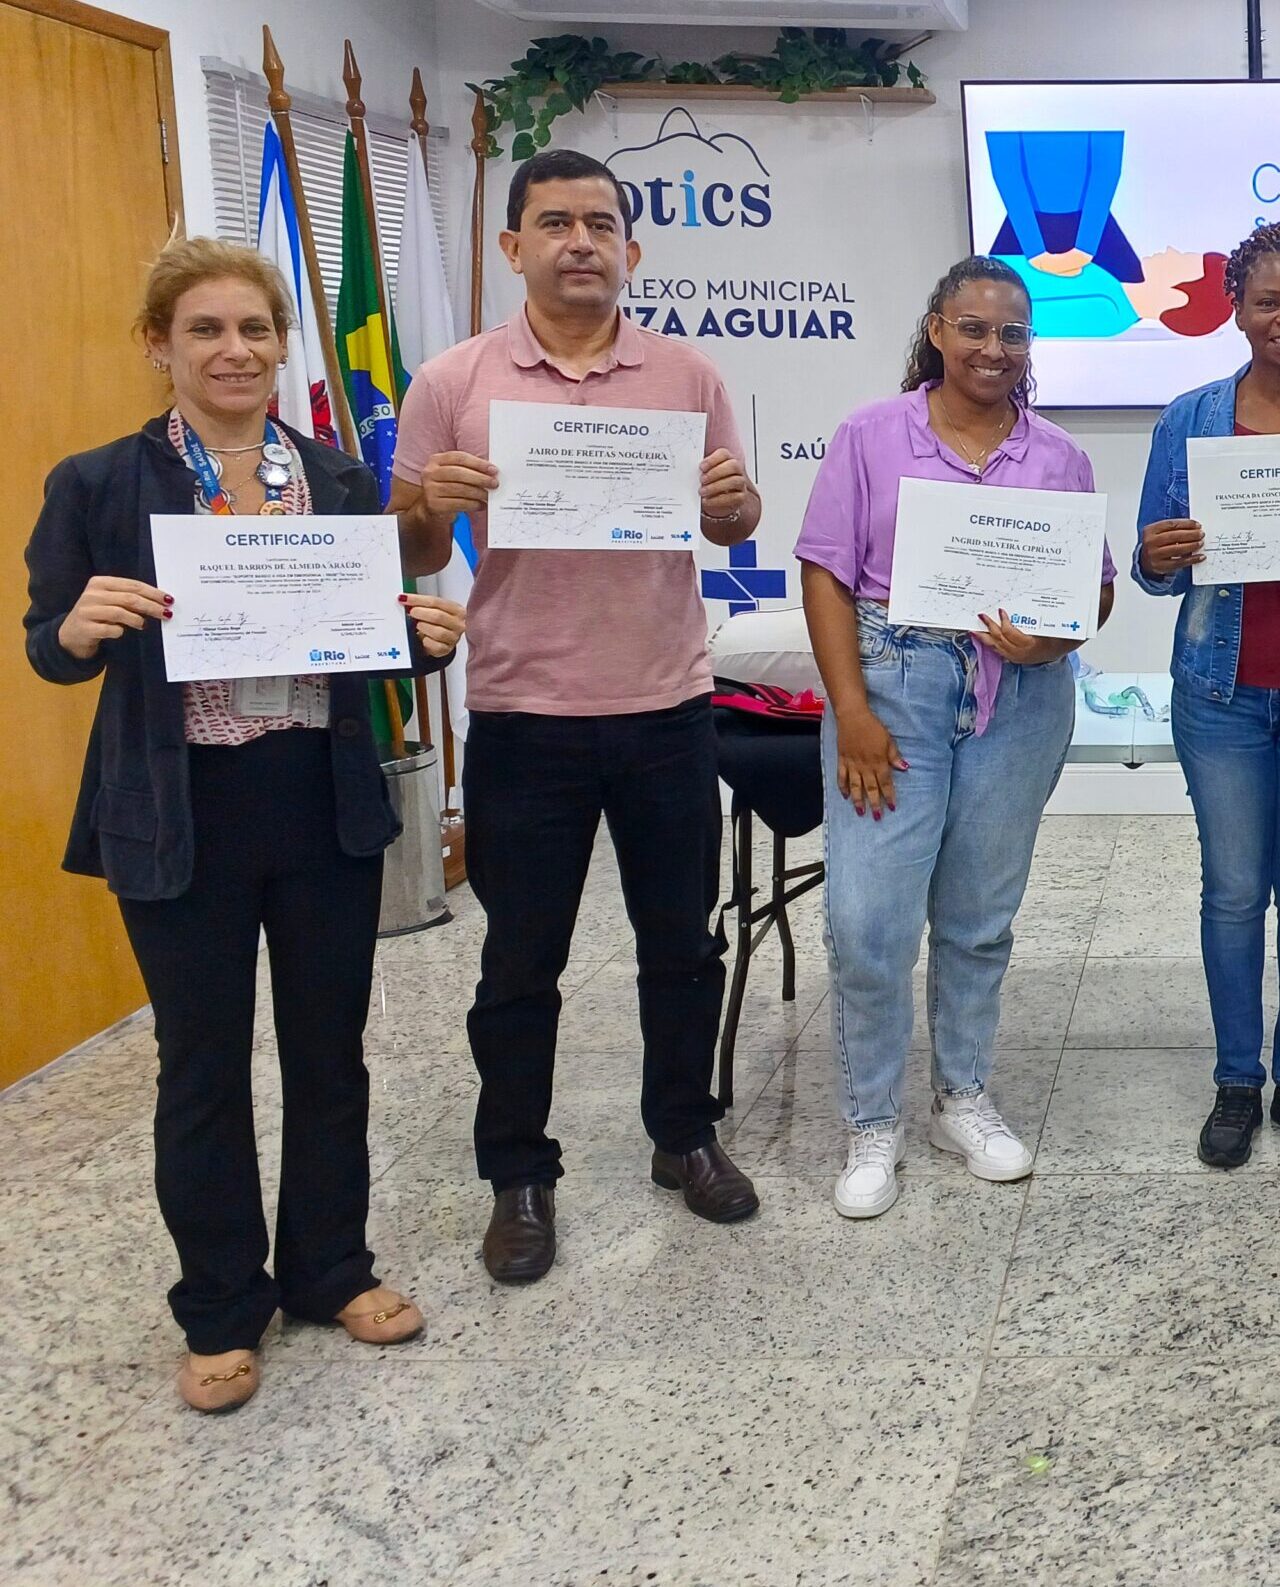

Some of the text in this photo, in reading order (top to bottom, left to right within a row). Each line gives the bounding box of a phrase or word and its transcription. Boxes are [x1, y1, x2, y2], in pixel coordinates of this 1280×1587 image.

[627, 278, 856, 304] LEXO MUNICIPAL
[696, 306, 857, 340] AGUIAR
[553, 421, 650, 437] CERTIFICADO
[528, 447, 668, 461] JAIRO DE FREITAS NOGUEIRA
[780, 437, 828, 461] SAÚ
[1215, 493, 1251, 501] FRANCISCA
[1251, 492, 1261, 500] DA
[969, 514, 1051, 533] CERTIFICADO
[225, 533, 335, 546] CERTIFICADO
[623, 530, 643, 540] Rio
[951, 536, 982, 547] INGRID
[982, 539, 1021, 551] SILVEIRA
[1022, 544, 1062, 555] CIPRIANO
[199, 561, 362, 572] RAQUEL BARROS DE ALMEIDA ARAÚJO
[1021, 616, 1037, 625] Rio
[323, 650, 346, 661] Rio
